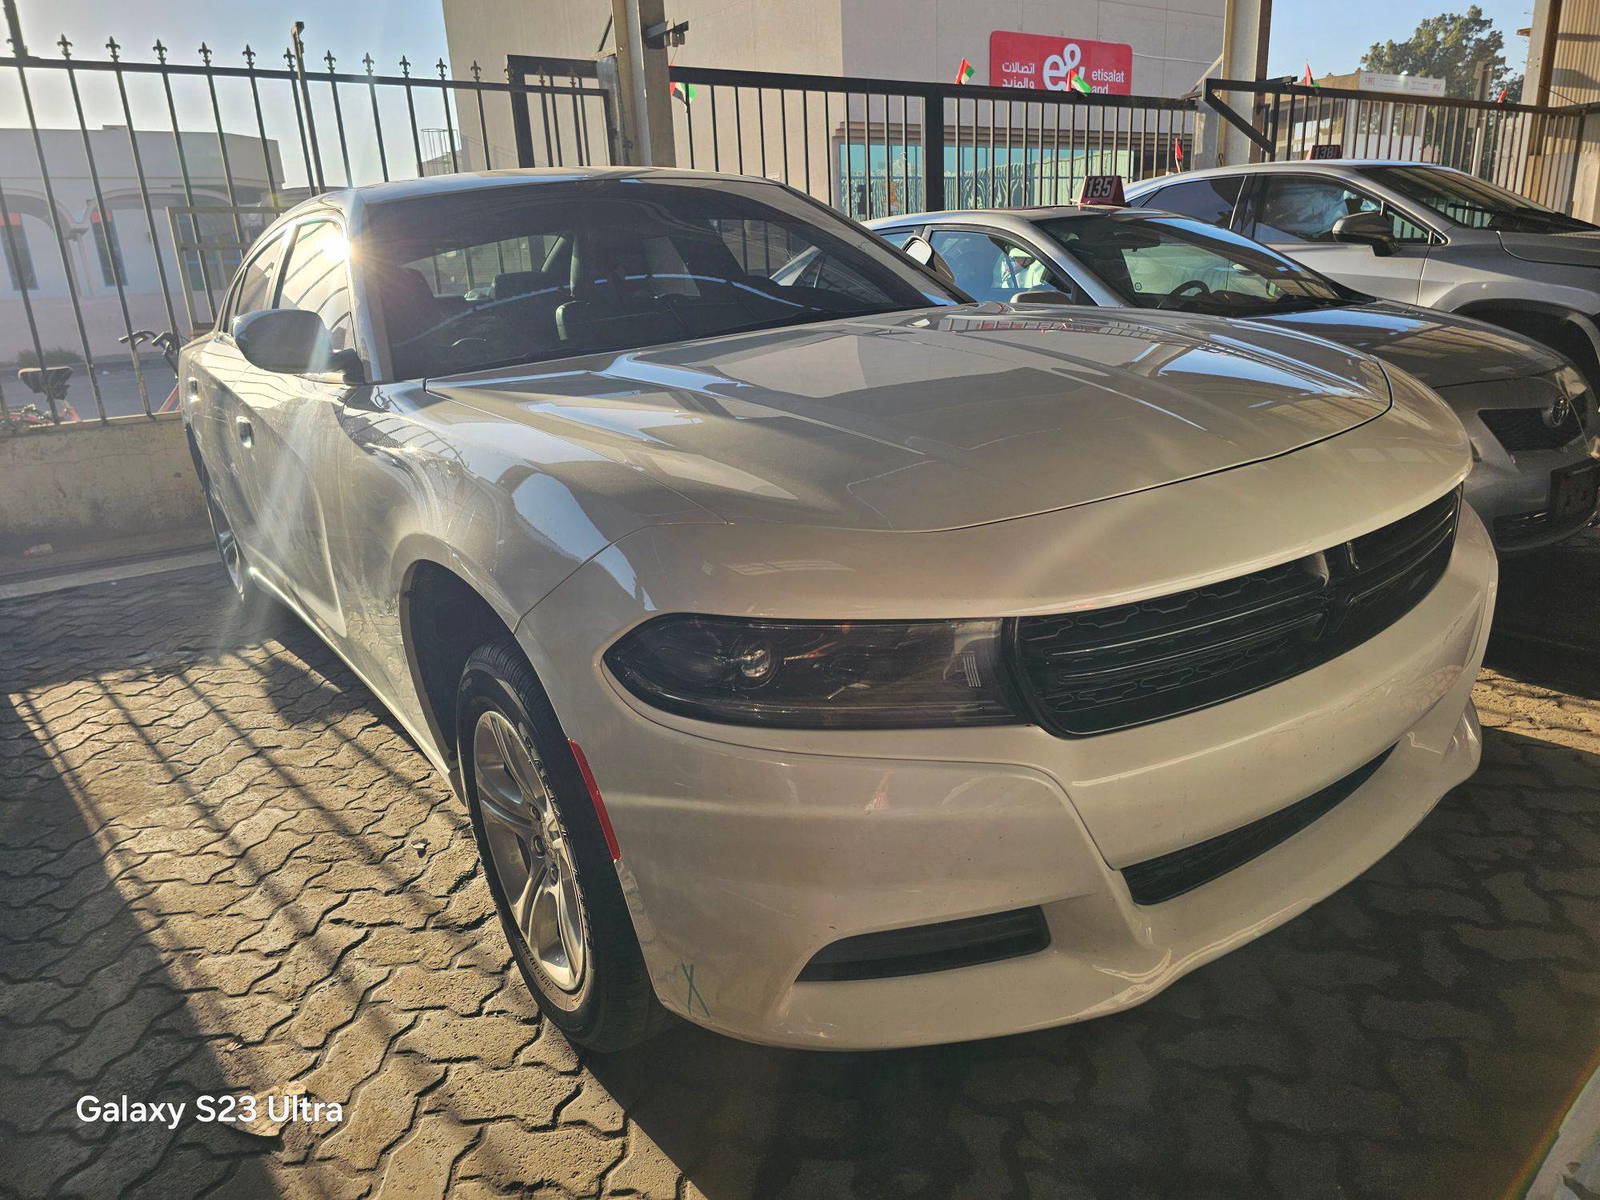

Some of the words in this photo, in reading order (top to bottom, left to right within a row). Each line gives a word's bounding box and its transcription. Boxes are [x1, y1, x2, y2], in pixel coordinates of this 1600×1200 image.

[1091, 68, 1125, 83] etisalat
[1091, 84, 1109, 94] and
[1087, 177, 1112, 197] 135
